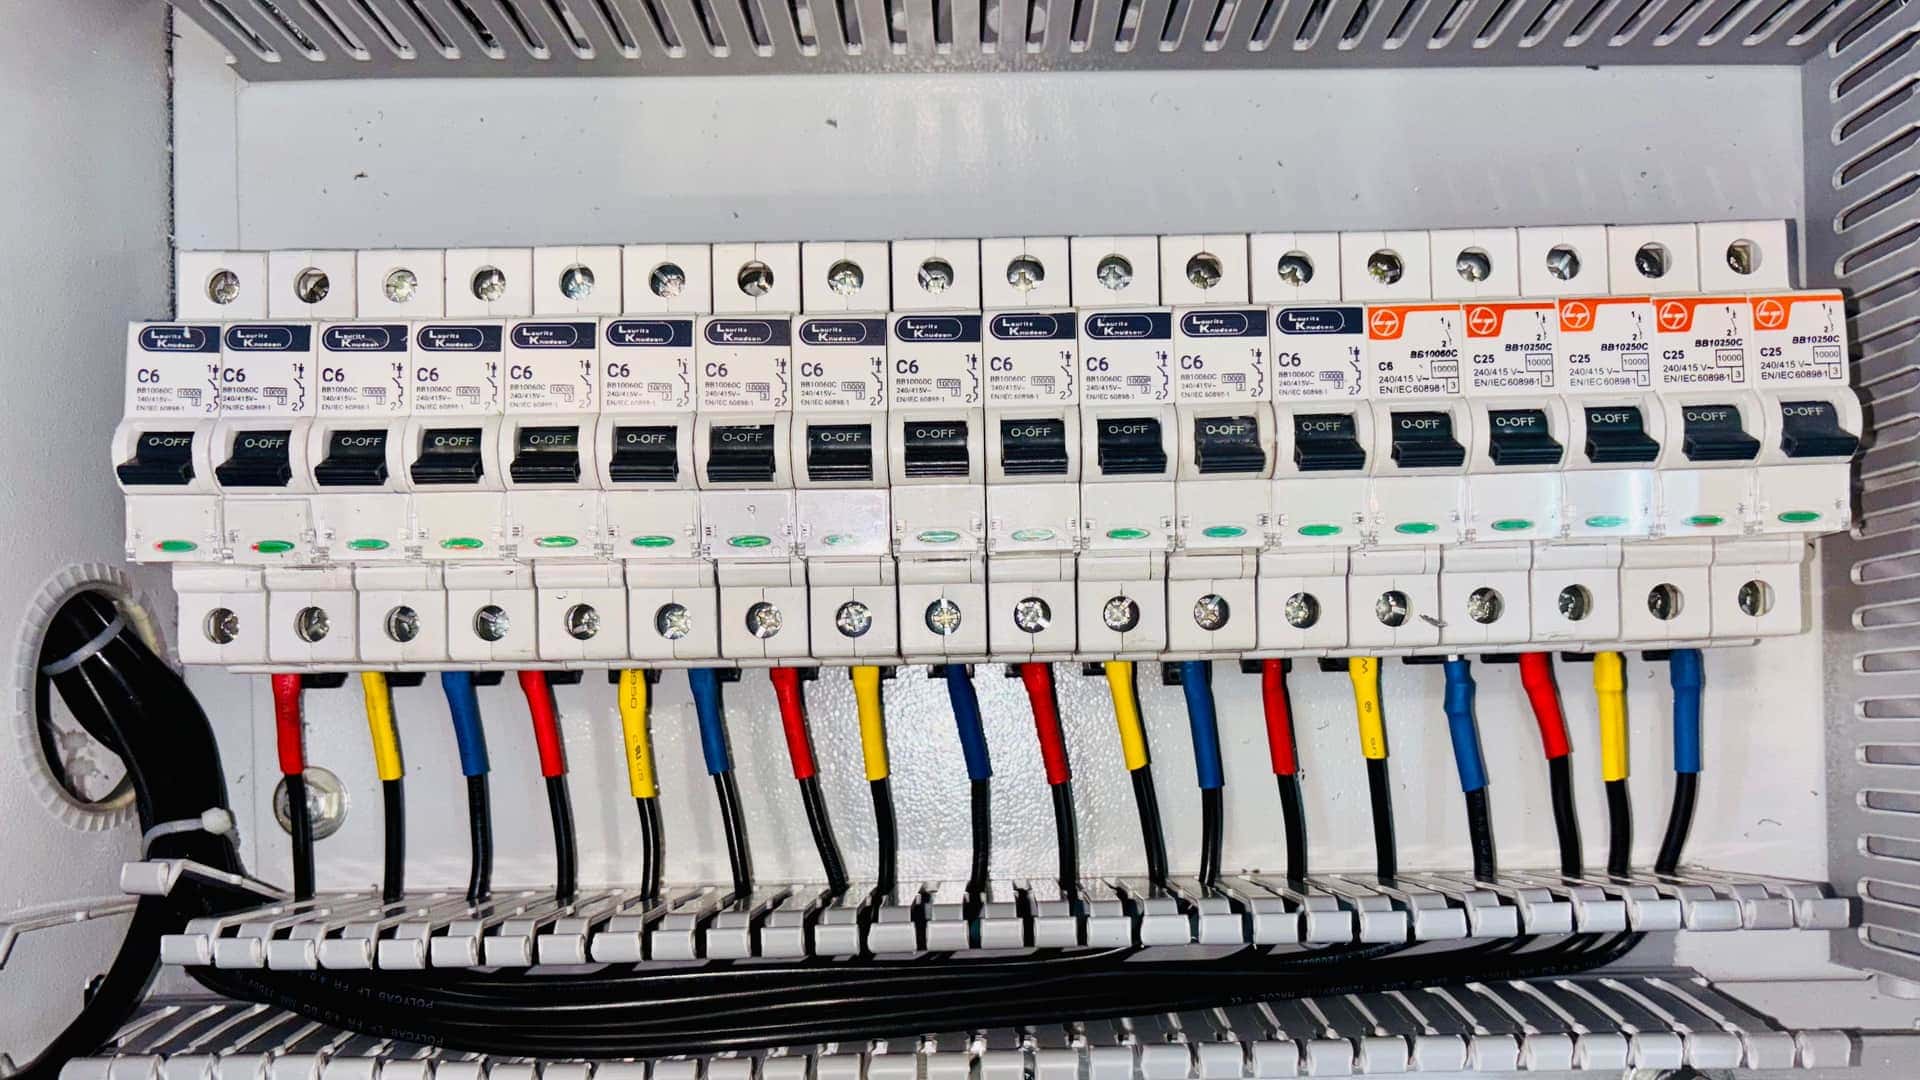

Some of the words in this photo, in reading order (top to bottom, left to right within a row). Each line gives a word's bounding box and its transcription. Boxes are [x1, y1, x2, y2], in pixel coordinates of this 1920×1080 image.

[1695, 339, 1742, 347] BB10250C
[1792, 335, 1840, 344] BB10250C
[1505, 343, 1552, 352] BB10250C
[1601, 343, 1648, 351] BB10250C
[1761, 348, 1782, 356] C25
[1181, 355, 1203, 369] C6
[1278, 353, 1301, 367] C6
[1474, 355, 1495, 363] C25
[1569, 354, 1590, 363] C25
[1663, 351, 1684, 359] C25
[608, 364, 630, 378] C6
[706, 363, 728, 377] C6
[801, 363, 823, 377] C6
[896, 360, 918, 374] C6
[990, 357, 1013, 371] C6
[1086, 357, 1108, 371] C6
[138, 369, 160, 383] C6
[223, 369, 246, 383] C6
[322, 368, 344, 382] C6
[417, 368, 439, 382] C6
[510, 366, 532, 380] C6
